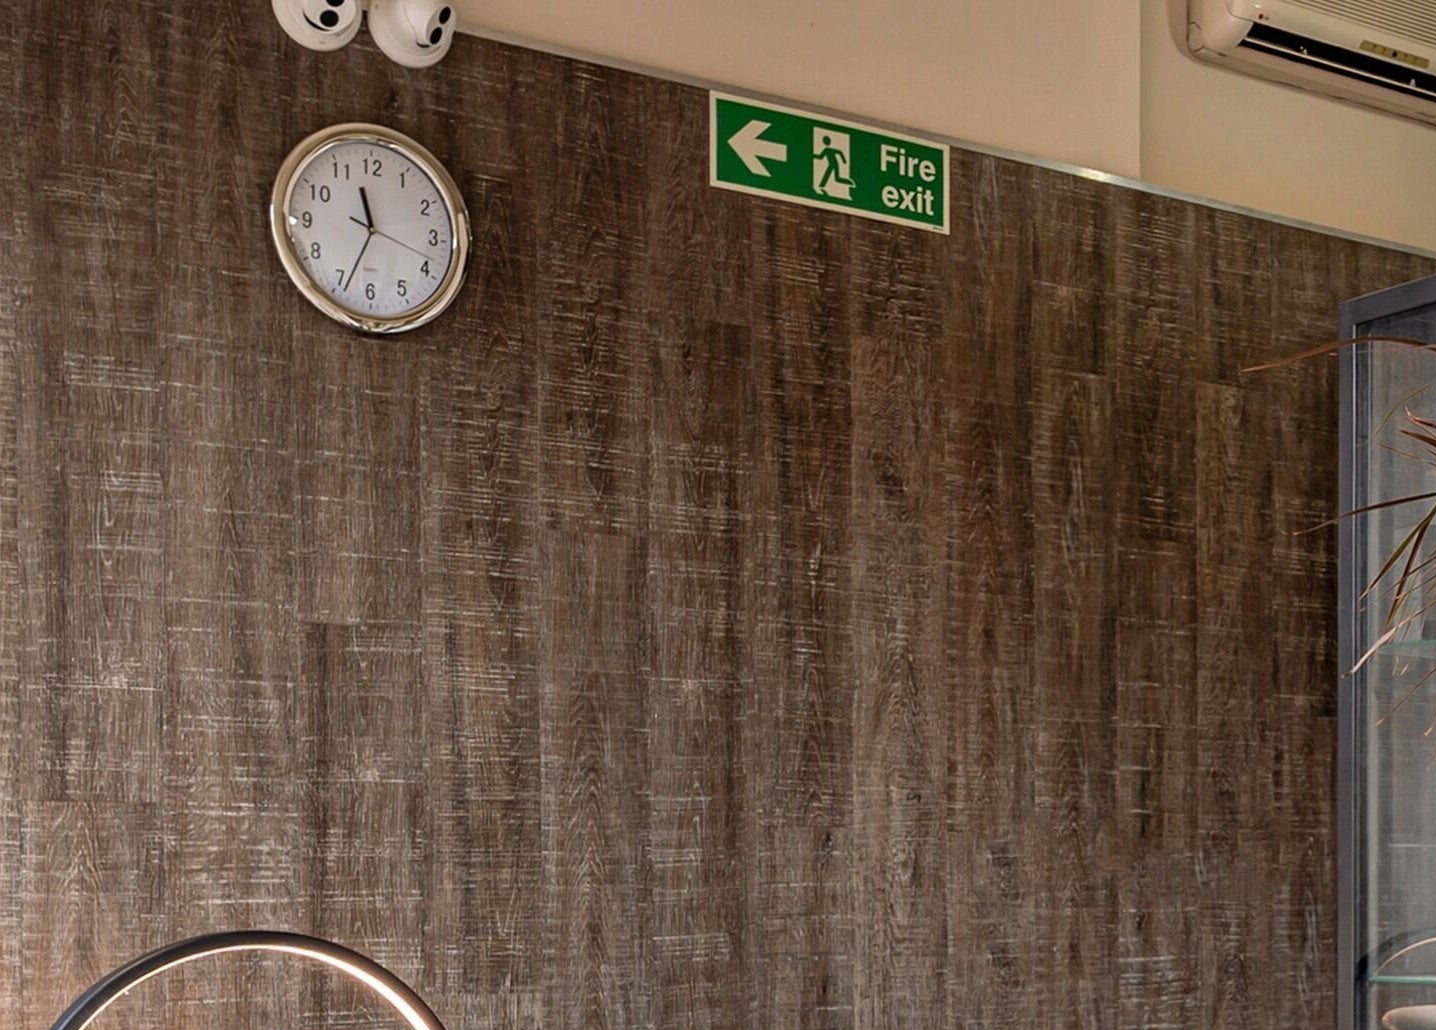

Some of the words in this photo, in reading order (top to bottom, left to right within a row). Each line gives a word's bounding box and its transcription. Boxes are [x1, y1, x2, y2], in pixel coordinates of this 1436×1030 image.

[332, 161, 350, 181] 11
[362, 158, 382, 177] 12
[880, 143, 937, 182] Fire
[399, 171, 406, 188] 1
[309, 184, 331, 203] 10
[881, 184, 935, 217] exit
[420, 199, 431, 217] 2
[302, 211, 313, 229] 9
[428, 229, 439, 247] 3
[310, 242, 321, 260] 8
[335, 269, 345, 286] 7
[420, 260, 430, 277] 4
[365, 283, 376, 301] 6
[396, 280, 408, 297] 5
